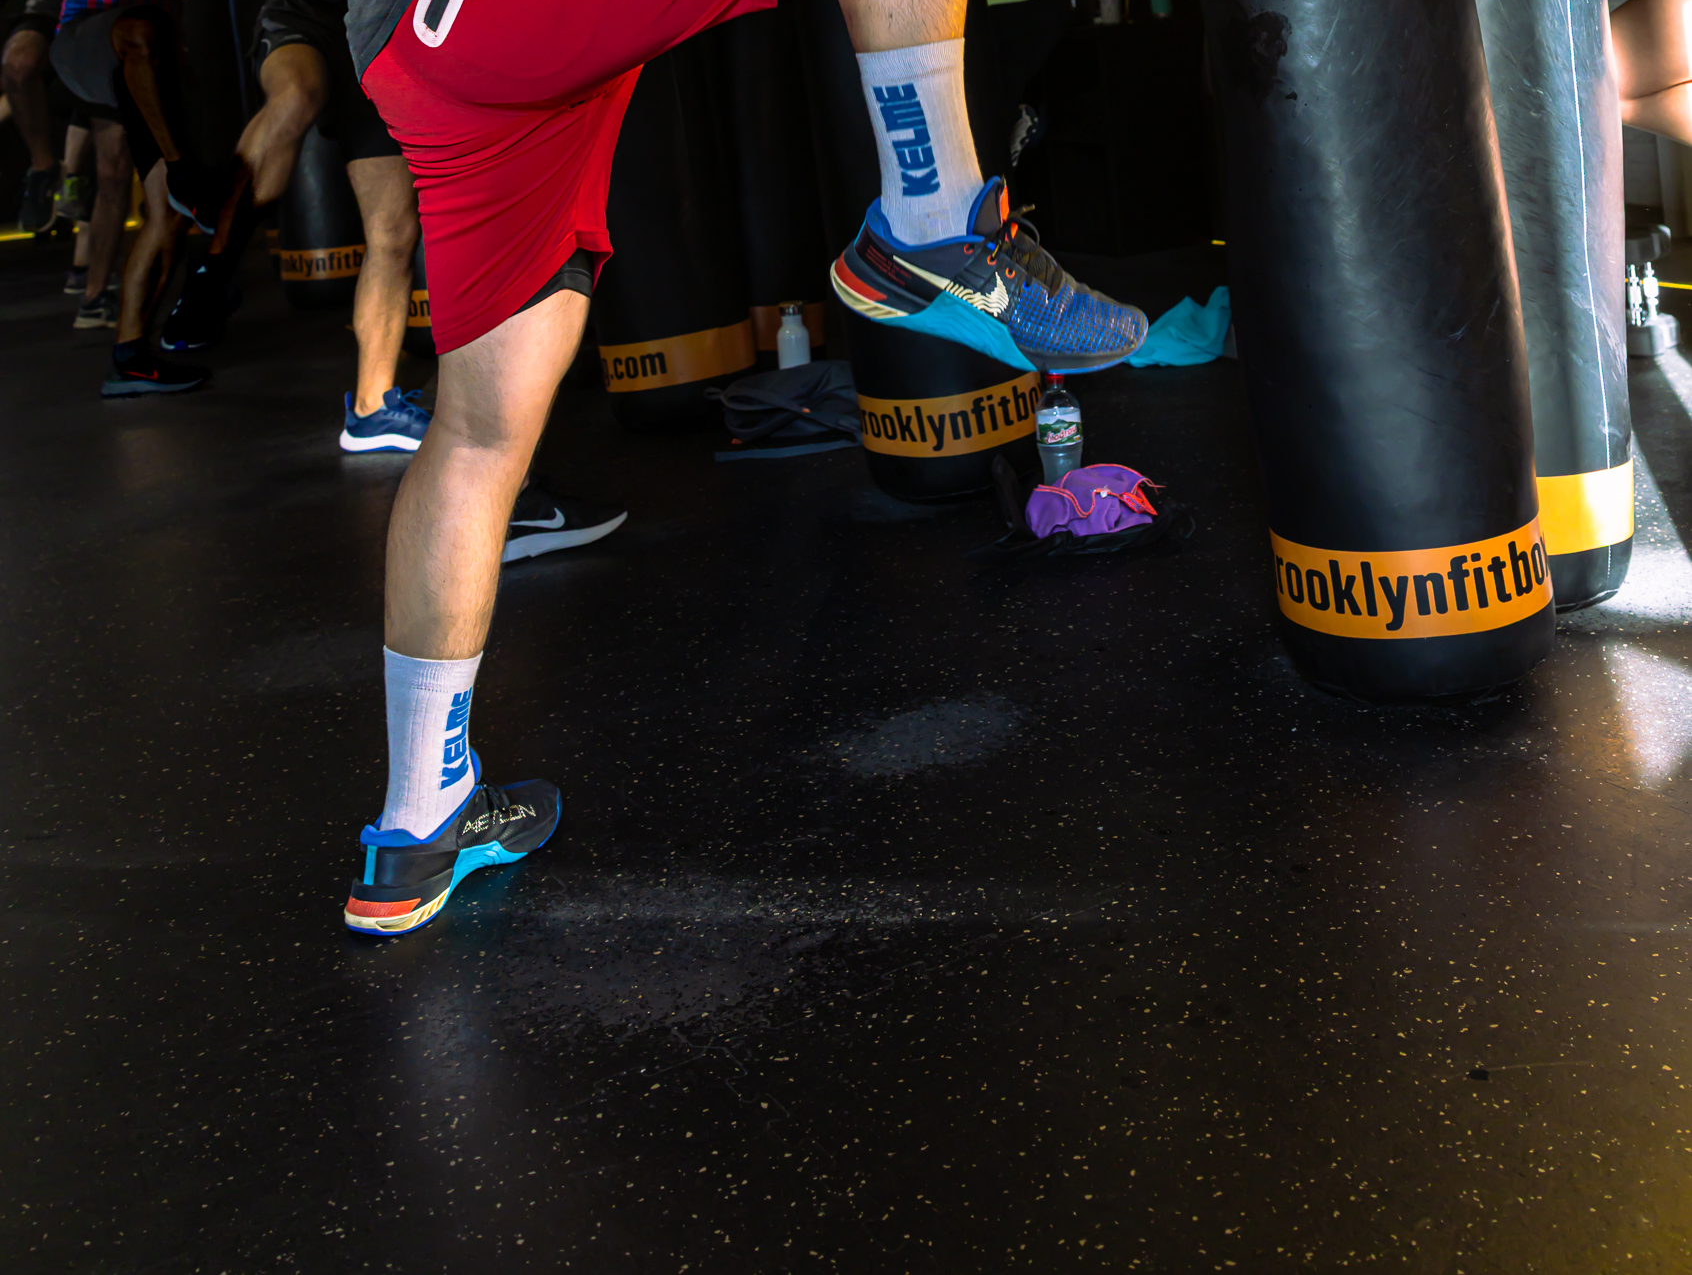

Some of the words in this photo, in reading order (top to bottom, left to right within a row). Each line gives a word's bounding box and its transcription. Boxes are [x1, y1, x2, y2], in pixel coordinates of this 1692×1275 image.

[873, 82, 940, 196] KELME
[860, 382, 1042, 451] rooklynfitbo
[440, 686, 473, 790] KELME
